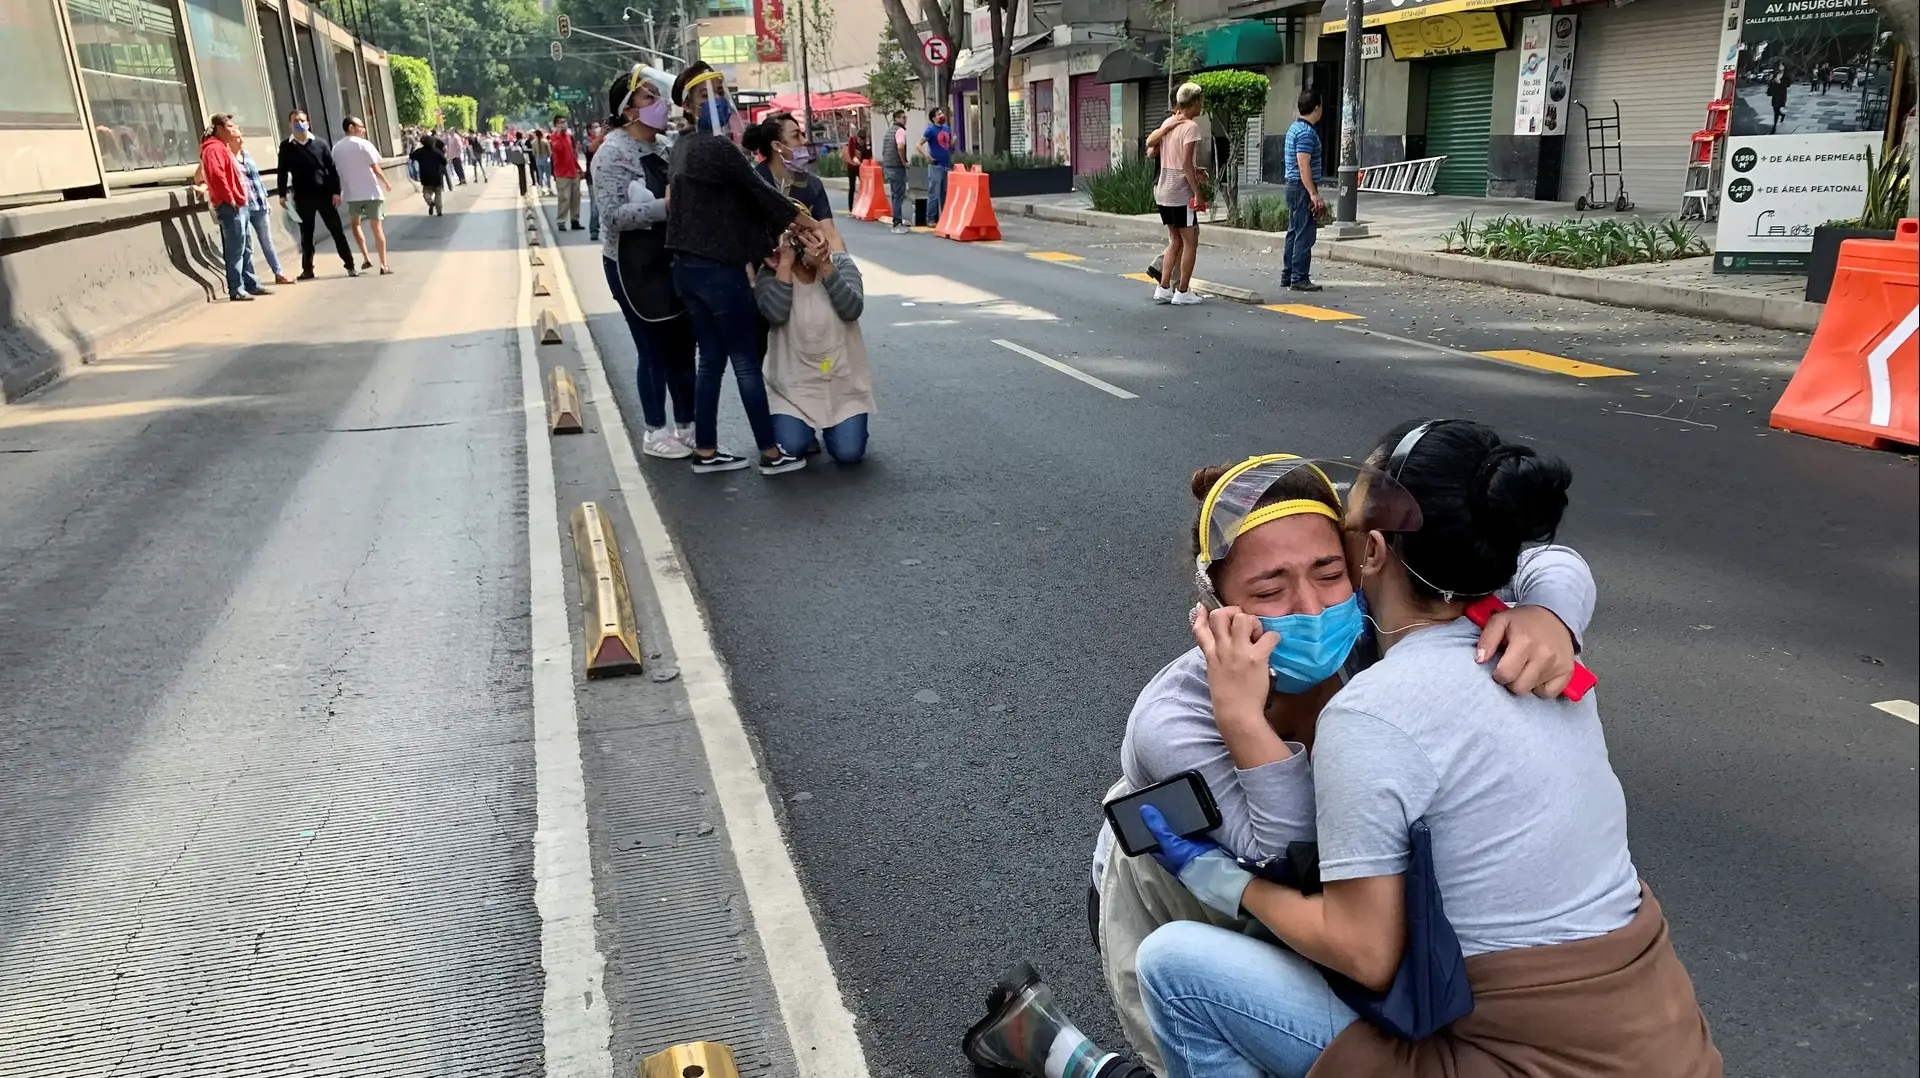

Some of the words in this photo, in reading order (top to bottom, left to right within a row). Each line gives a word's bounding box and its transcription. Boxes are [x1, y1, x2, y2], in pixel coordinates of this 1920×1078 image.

[1765, 3, 1784, 14] AV.
[1745, 17, 1766, 25] CALLE
[1767, 15, 1793, 23] PUEBLA
[1820, 11, 1834, 19] SUR
[1835, 9, 1854, 17] BAJA
[1855, 8, 1878, 16] CALIF
[931, 43, 942, 60] E
[1769, 155, 1782, 163] DE
[1785, 153, 1812, 163] ÁREA
[1766, 186, 1779, 194] DE
[1781, 184, 1808, 193] ÁREA
[1810, 185, 1863, 193] PEATONAL
